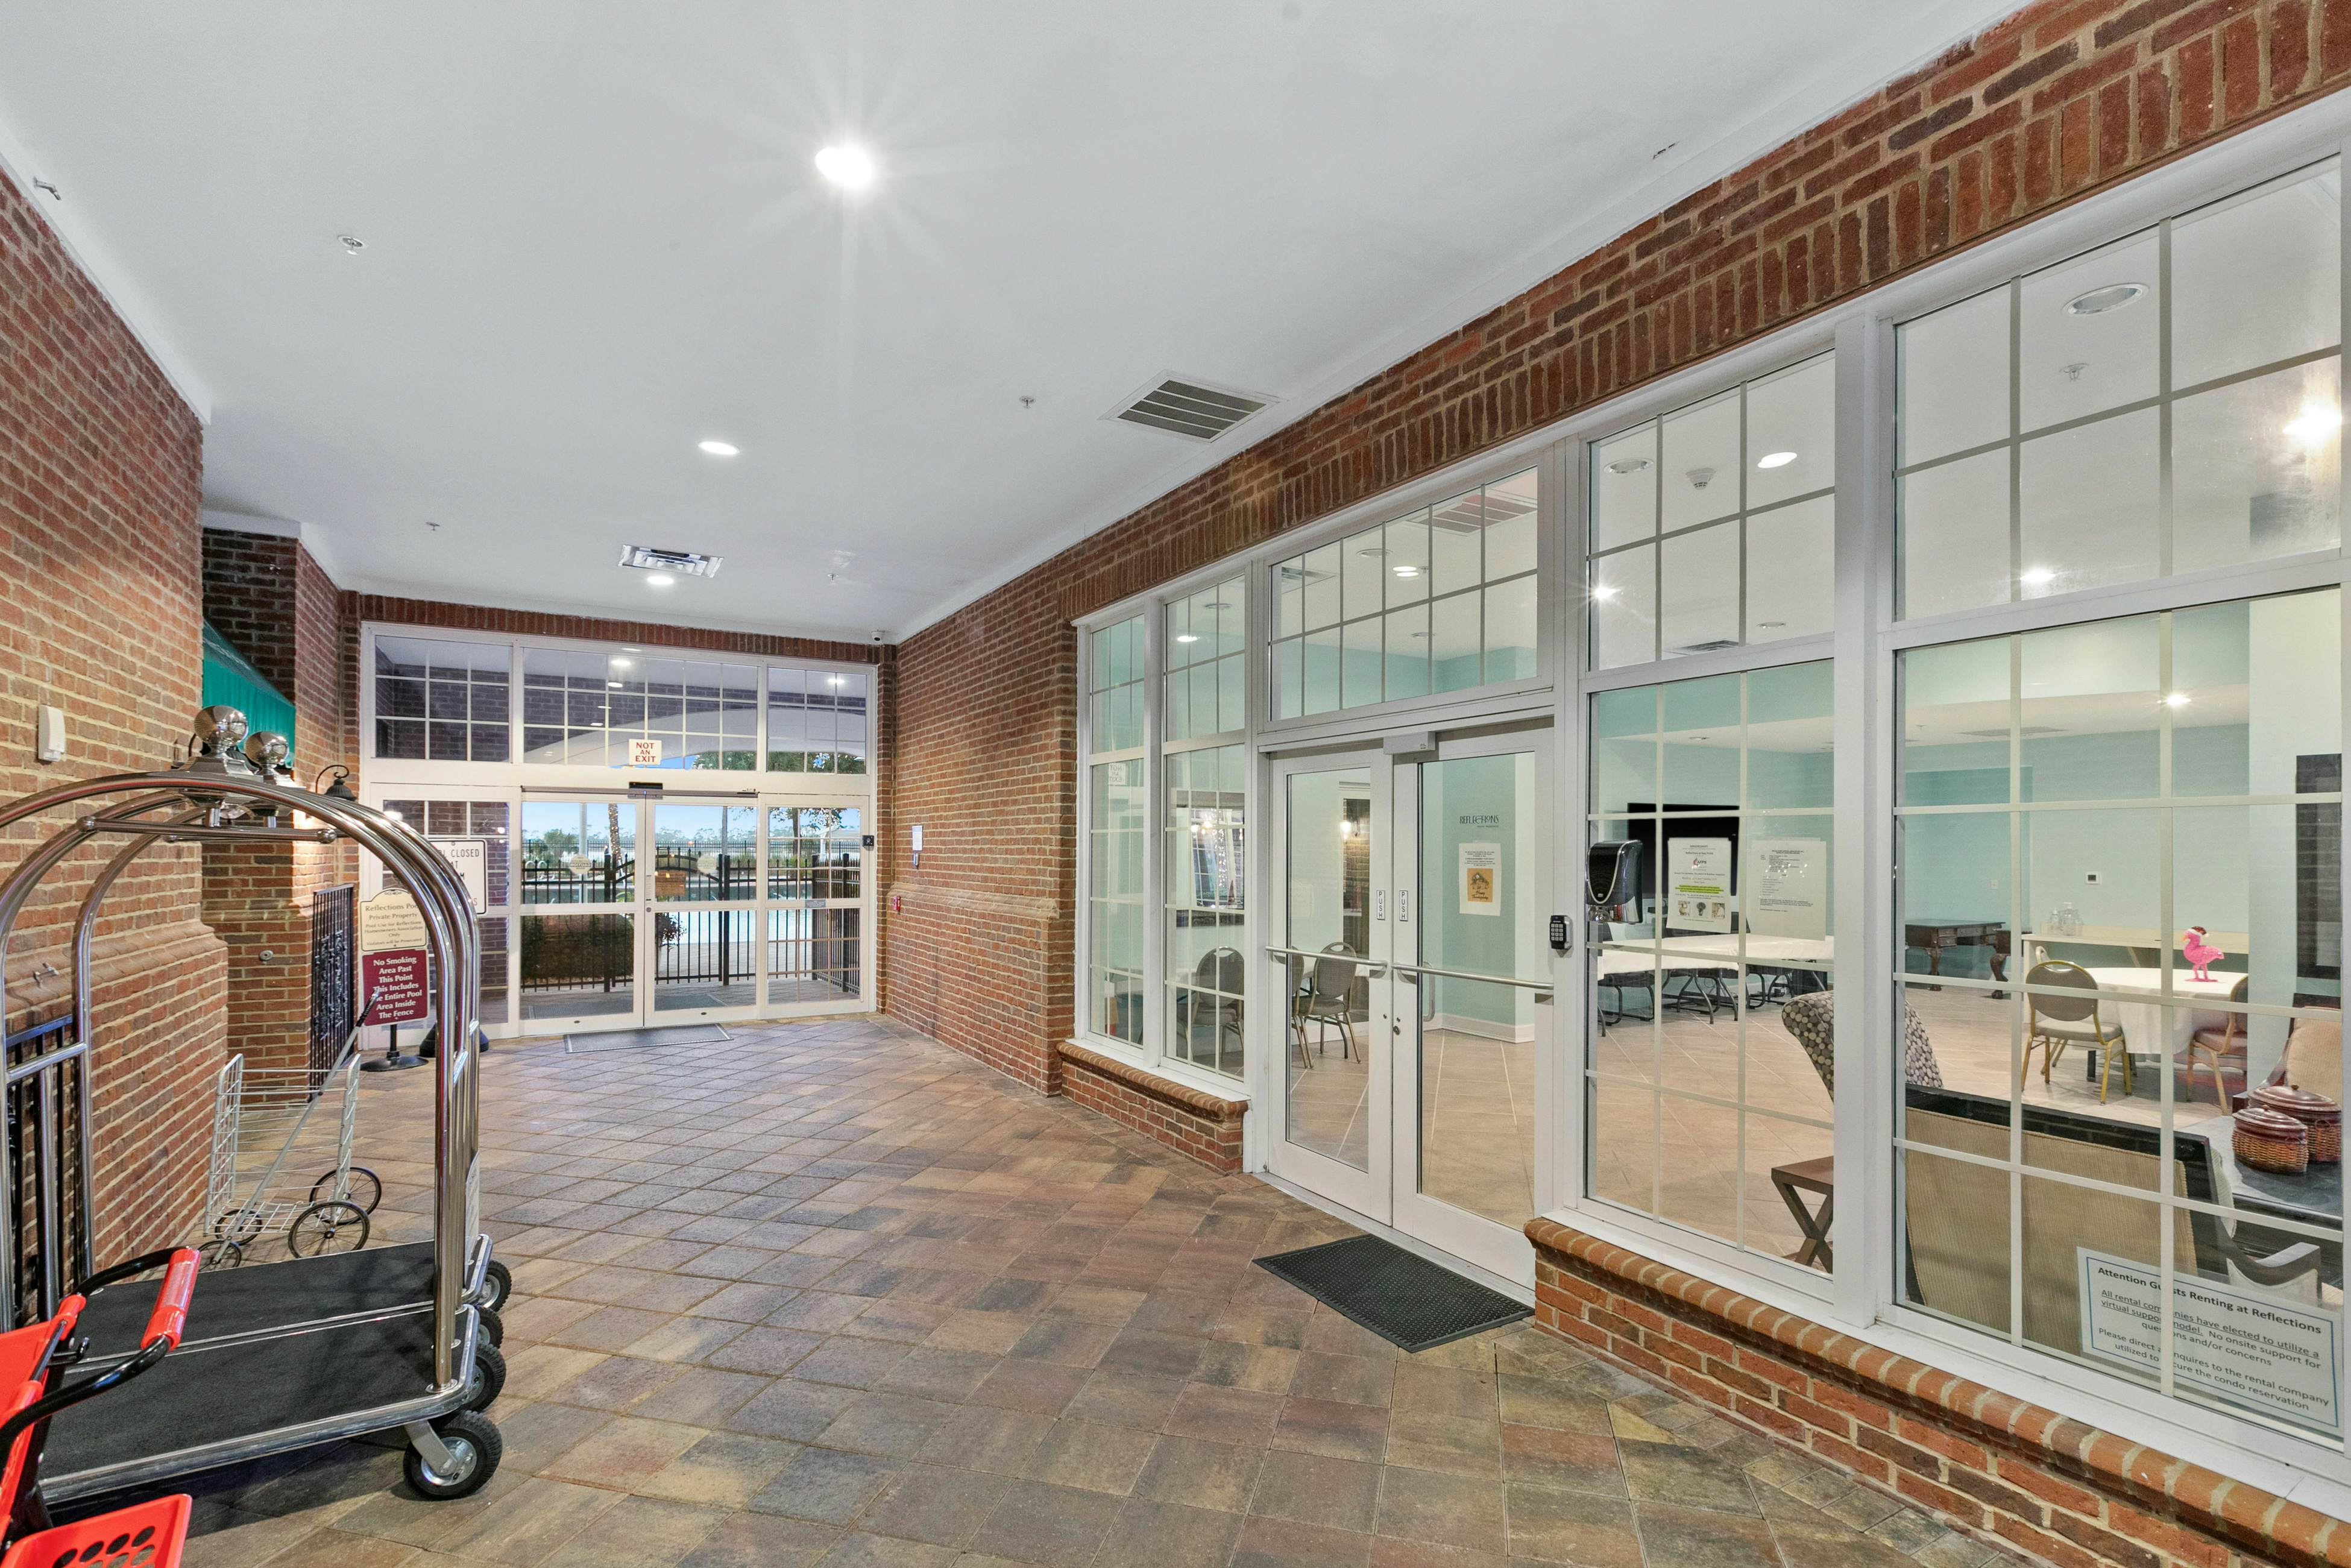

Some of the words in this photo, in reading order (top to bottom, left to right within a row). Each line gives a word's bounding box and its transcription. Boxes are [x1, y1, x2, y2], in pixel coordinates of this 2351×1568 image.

[1459, 815, 1499, 825] REFLECTIONS
[451, 849, 479, 857] CLOSED
[395, 1000, 416, 1008] Inside
[407, 989, 422, 998] Pool
[2098, 1267, 2147, 1286] Attention
[2150, 1281, 2186, 1297] Gsts
[2189, 1291, 2234, 1311] Renting
[2236, 1306, 2249, 1314] at
[2252, 1308, 2321, 1334] Reflections
[2101, 1289, 2112, 1298] All
[2115, 1294, 2141, 1306] rental
[2143, 1302, 2194, 1321] comnies
[2197, 1316, 2220, 1329] have
[2223, 1324, 2260, 1341] elected
[2263, 1335, 2274, 1345] to
[2277, 1340, 2309, 1355] utilize
[2101, 1300, 2129, 1313] virtual
[2132, 1308, 2161, 1322] suppo
[2209, 1330, 2223, 1341] No
[2226, 1336, 2257, 1351] onsite
[2260, 1346, 2302, 1364] support
[2305, 1358, 2321, 1369] for
[2189, 1336, 2223, 1350] and/or
[2226, 1347, 2272, 1366] concerns
[2099, 1328, 2126, 1342] Please
[2129, 1337, 2154, 1351] direct
[2174, 1352, 2209, 1368] nquires
[2212, 1363, 2222, 1372] to
[2225, 1367, 2242, 1379] the
[2245, 1374, 2275, 1389] rental
[2278, 1385, 2329, 1406] company
[2115, 1343, 2147, 1358] utilized
[2150, 1354, 2159, 1362] to
[2173, 1362, 2192, 1373] cure
[2195, 1367, 2211, 1379] the
[2215, 1373, 2246, 1390] condo
[2249, 1386, 2309, 1411] reservation
